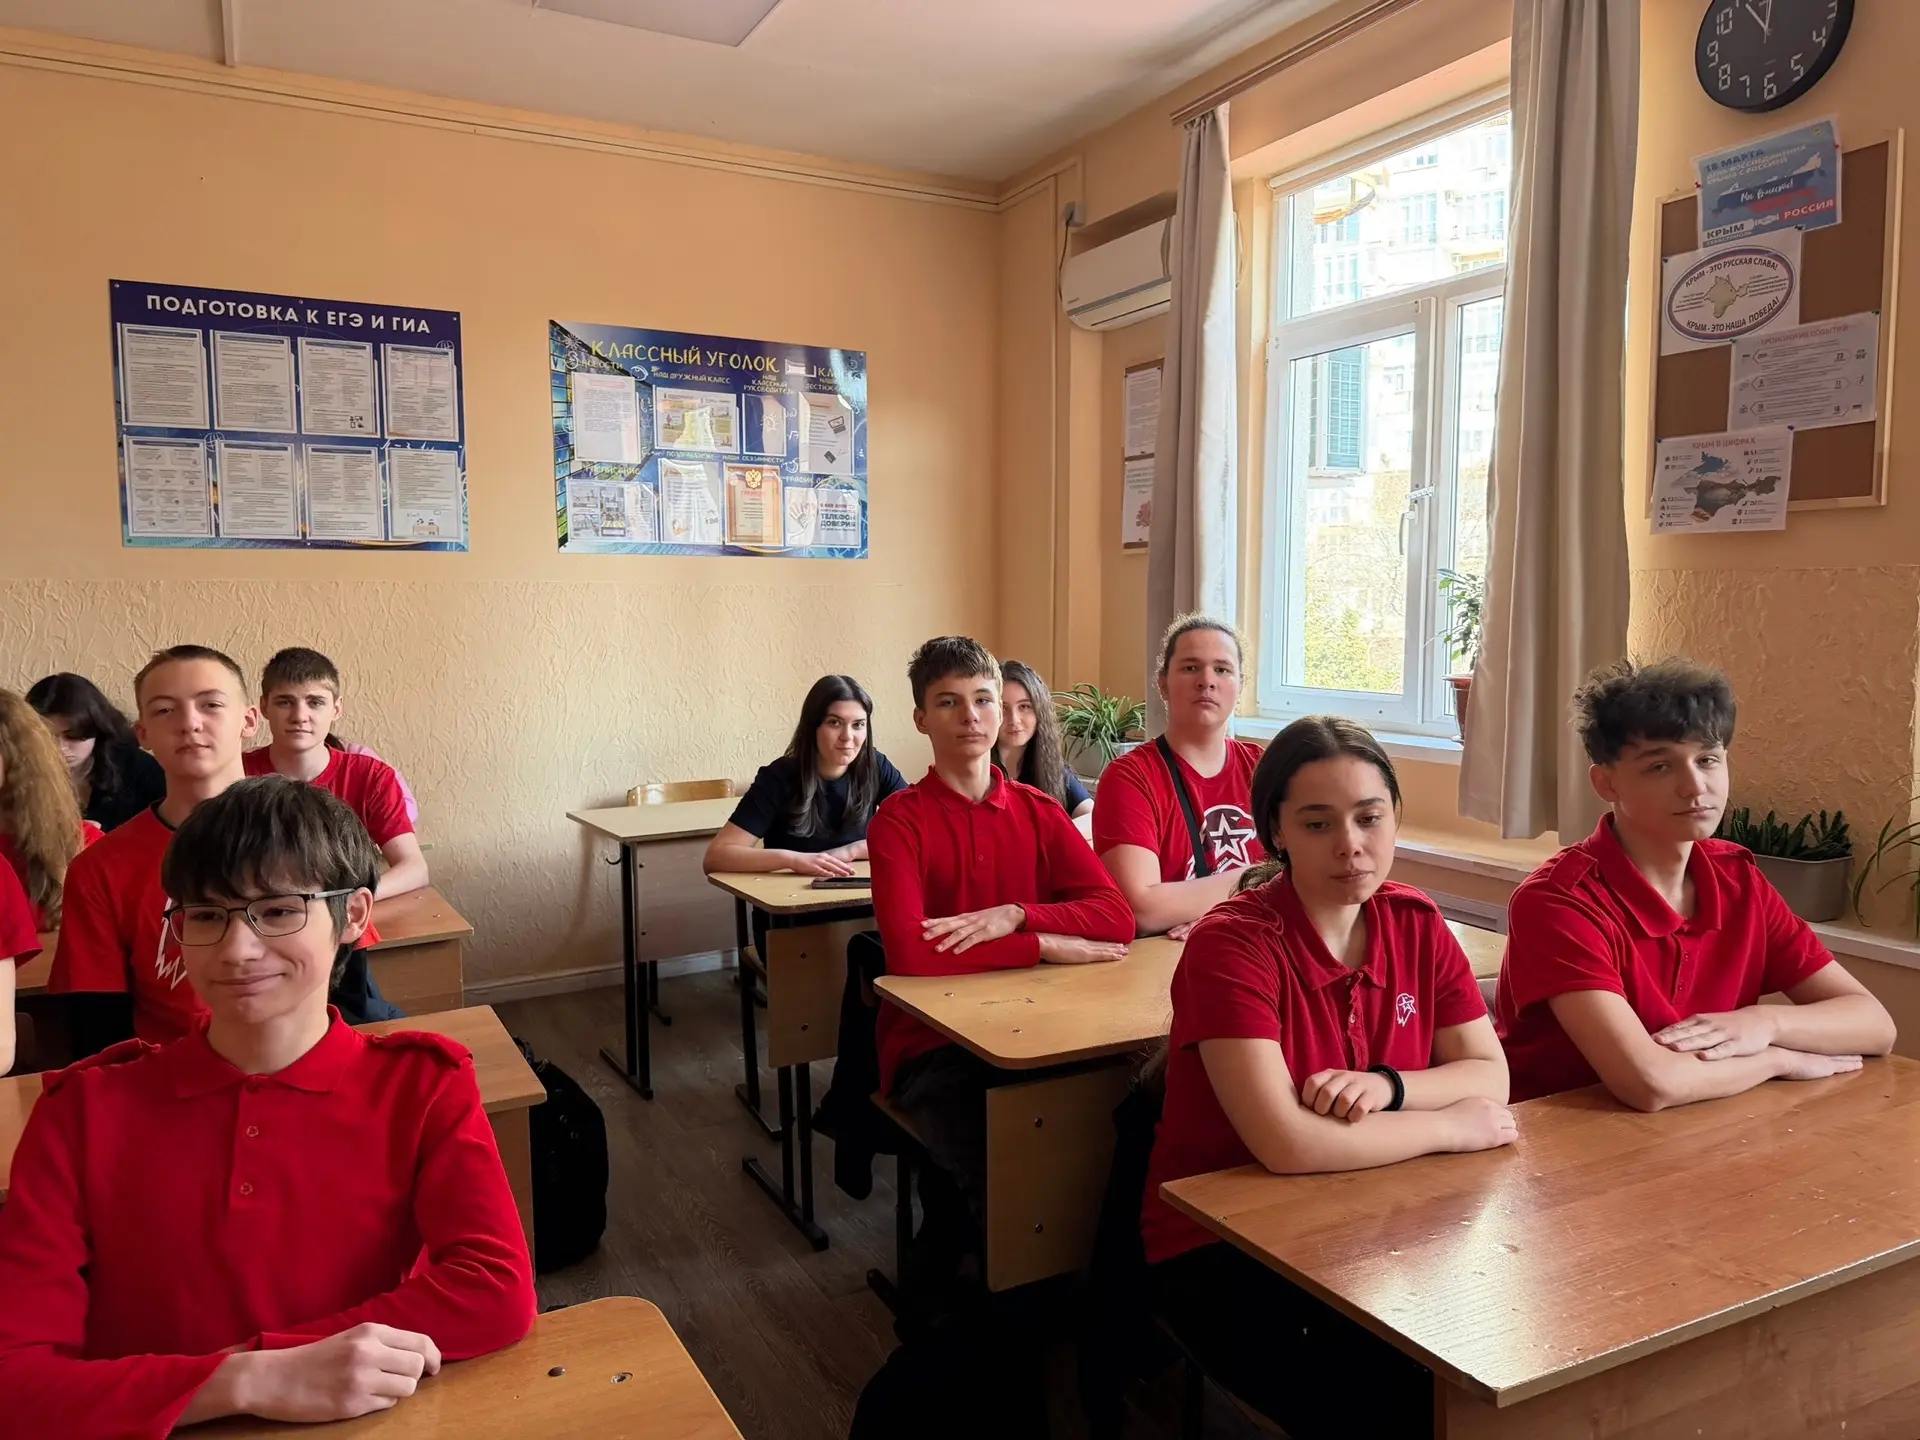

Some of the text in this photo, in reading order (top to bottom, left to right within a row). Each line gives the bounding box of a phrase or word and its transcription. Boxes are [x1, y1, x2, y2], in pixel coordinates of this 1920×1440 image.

[1716, 7, 1733, 36] 10
[1812, 26, 1827, 48] 4
[1706, 40, 1719, 68] 9
[1718, 63, 1731, 91] 8
[1790, 52, 1804, 83] 5
[1738, 74, 1750, 98] 7
[1763, 71, 1777, 100] 6
[1720, 148, 1765, 167] МАРТА
[1784, 199, 1834, 220] РОССИЯ
[1706, 223, 1745, 239] КРЫМ
[1685, 269, 1706, 288] КРЫМ
[1709, 263, 1722, 273] ЭТО
[1723, 257, 1753, 269] РУССКАЯ
[1753, 257, 1779, 271] СЛАВА!
[146, 294, 431, 334] ПОДГОТОВКА К ЕГЭ И ГИА
[1686, 320, 1706, 332] КРЫМ
[1711, 324, 1725, 333] ЭТО
[1726, 318, 1747, 331] НАША
[1748, 296, 1780, 323] ПОБЕДА!
[581, 359, 623, 370] НОВОСТИ
[591, 341, 780, 373] КЛАССНЫЙ УГОЛОК
[670, 372, 707, 382] ДРУЖНЫЙ
[707, 375, 731, 384] КЛАСС
[820, 513, 856, 521] ТЕЛЕФОН
[820, 520, 856, 528] ДОВЕРИЯ
